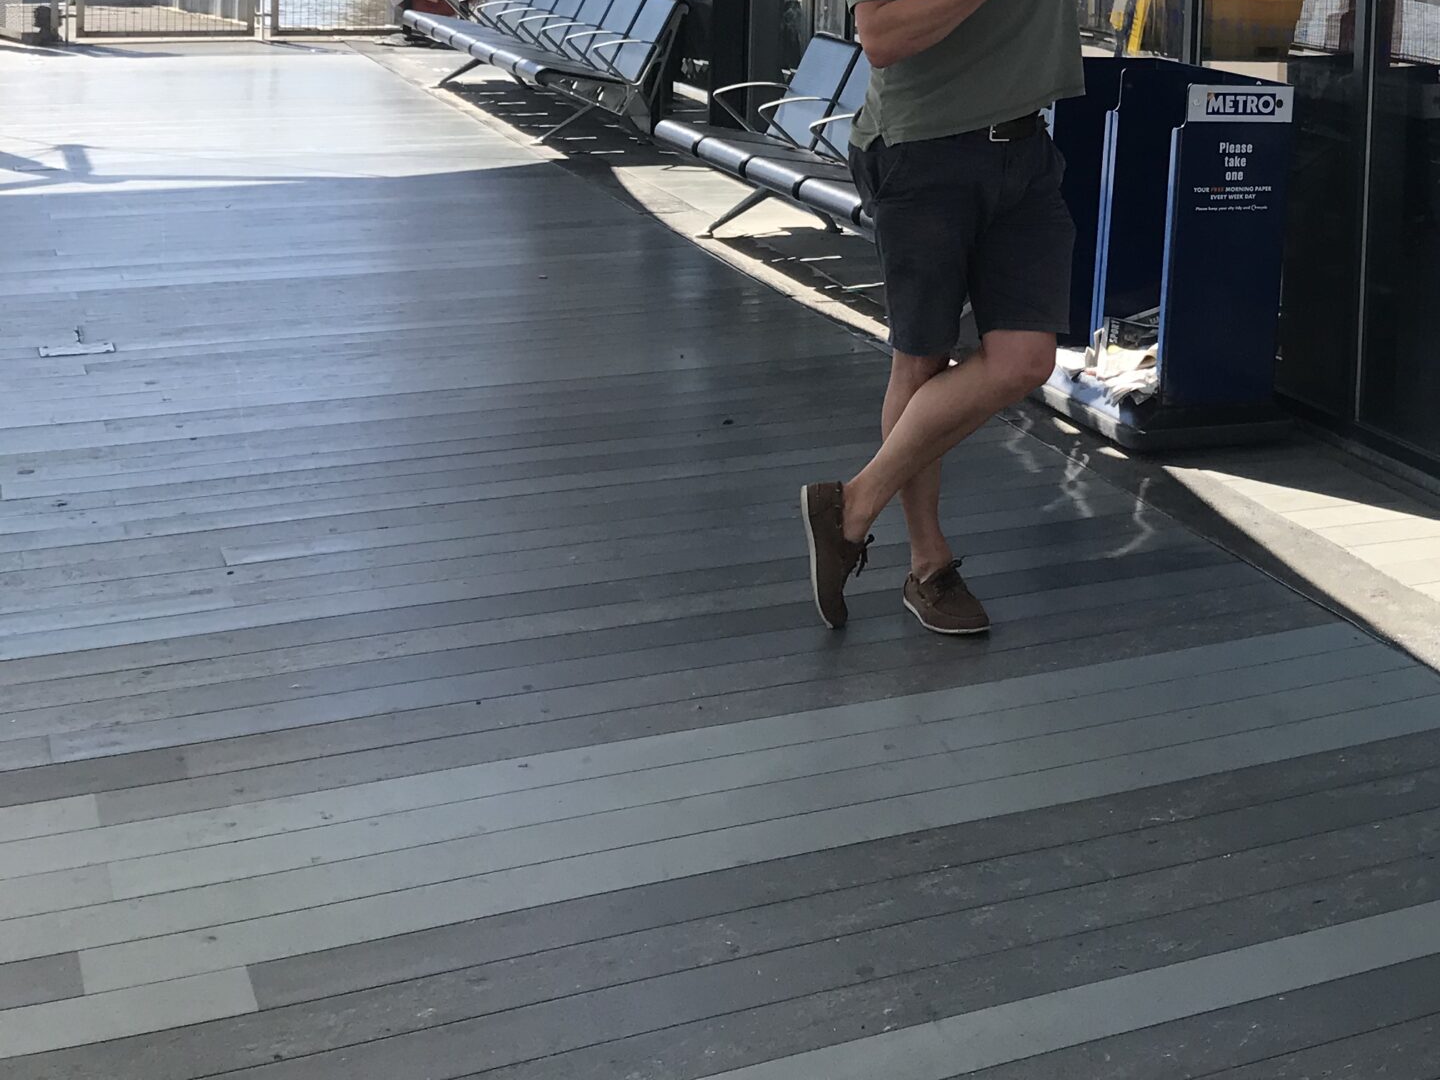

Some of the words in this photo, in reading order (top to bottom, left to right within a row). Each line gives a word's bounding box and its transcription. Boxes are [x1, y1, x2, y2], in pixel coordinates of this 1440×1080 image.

[1207, 95, 1276, 113] METRO
[1219, 142, 1253, 154] Please
[1224, 156, 1247, 167] take
[1225, 171, 1244, 181] one
